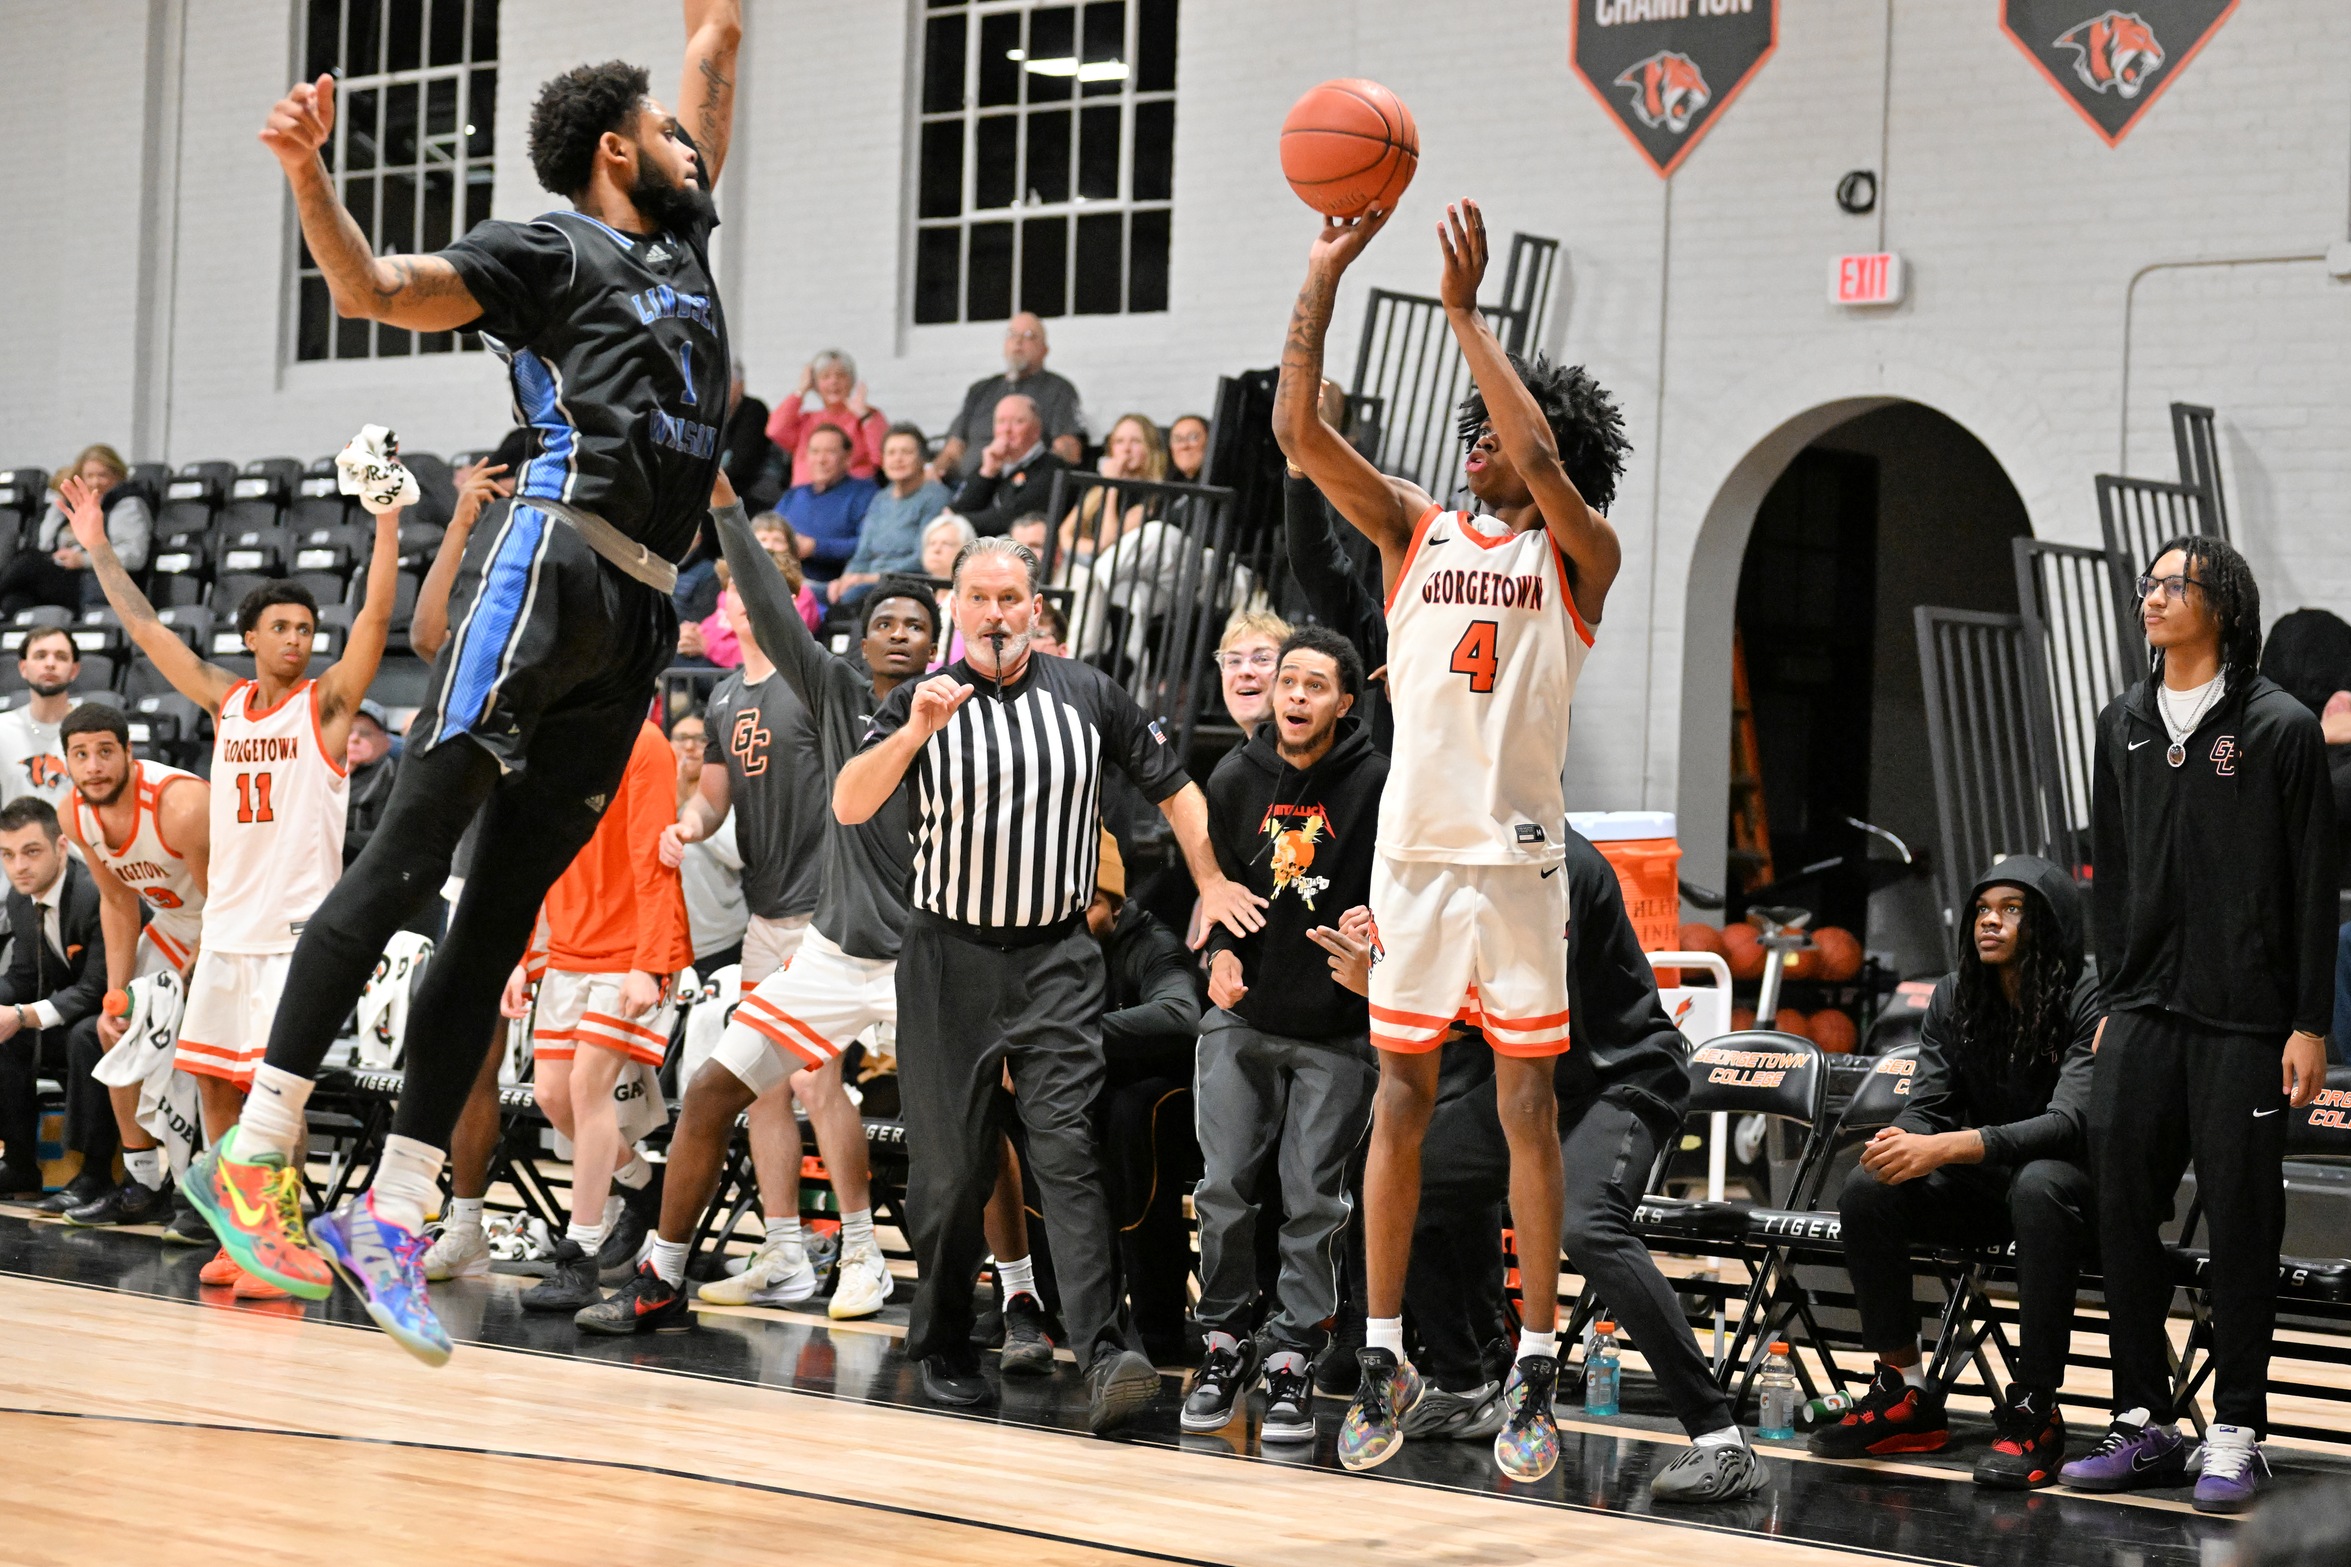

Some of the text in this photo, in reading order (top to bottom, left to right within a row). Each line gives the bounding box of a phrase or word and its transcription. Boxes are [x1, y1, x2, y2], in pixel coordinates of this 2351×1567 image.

[1839, 253, 1891, 301] EXIT
[680, 340, 697, 406] 1
[1422, 569, 1544, 612] GEORGETOWN
[1449, 619, 1499, 693] 4
[236, 772, 274, 823] 11
[1693, 1048, 1811, 1069] GEORGETOWN
[1708, 1067, 1787, 1088] COLLEGE
